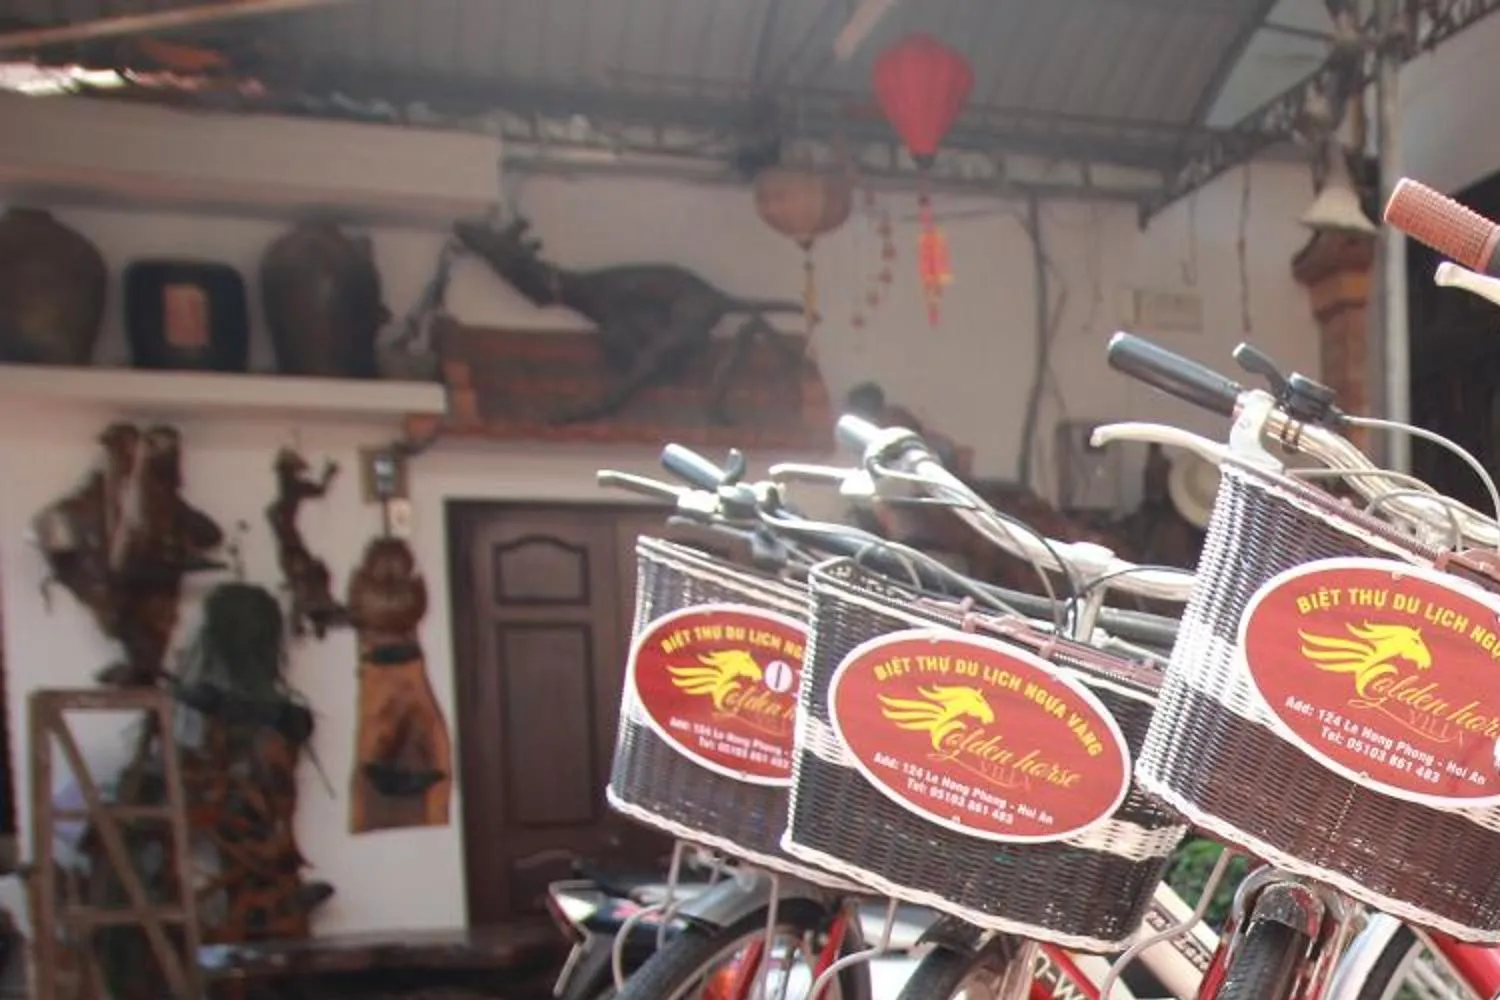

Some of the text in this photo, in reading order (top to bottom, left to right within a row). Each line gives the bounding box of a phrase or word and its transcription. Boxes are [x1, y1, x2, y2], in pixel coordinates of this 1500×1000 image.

[1392, 592, 1421, 615] DU
[955, 658, 980, 678] DU
[1355, 663, 1500, 738] Golden hor
